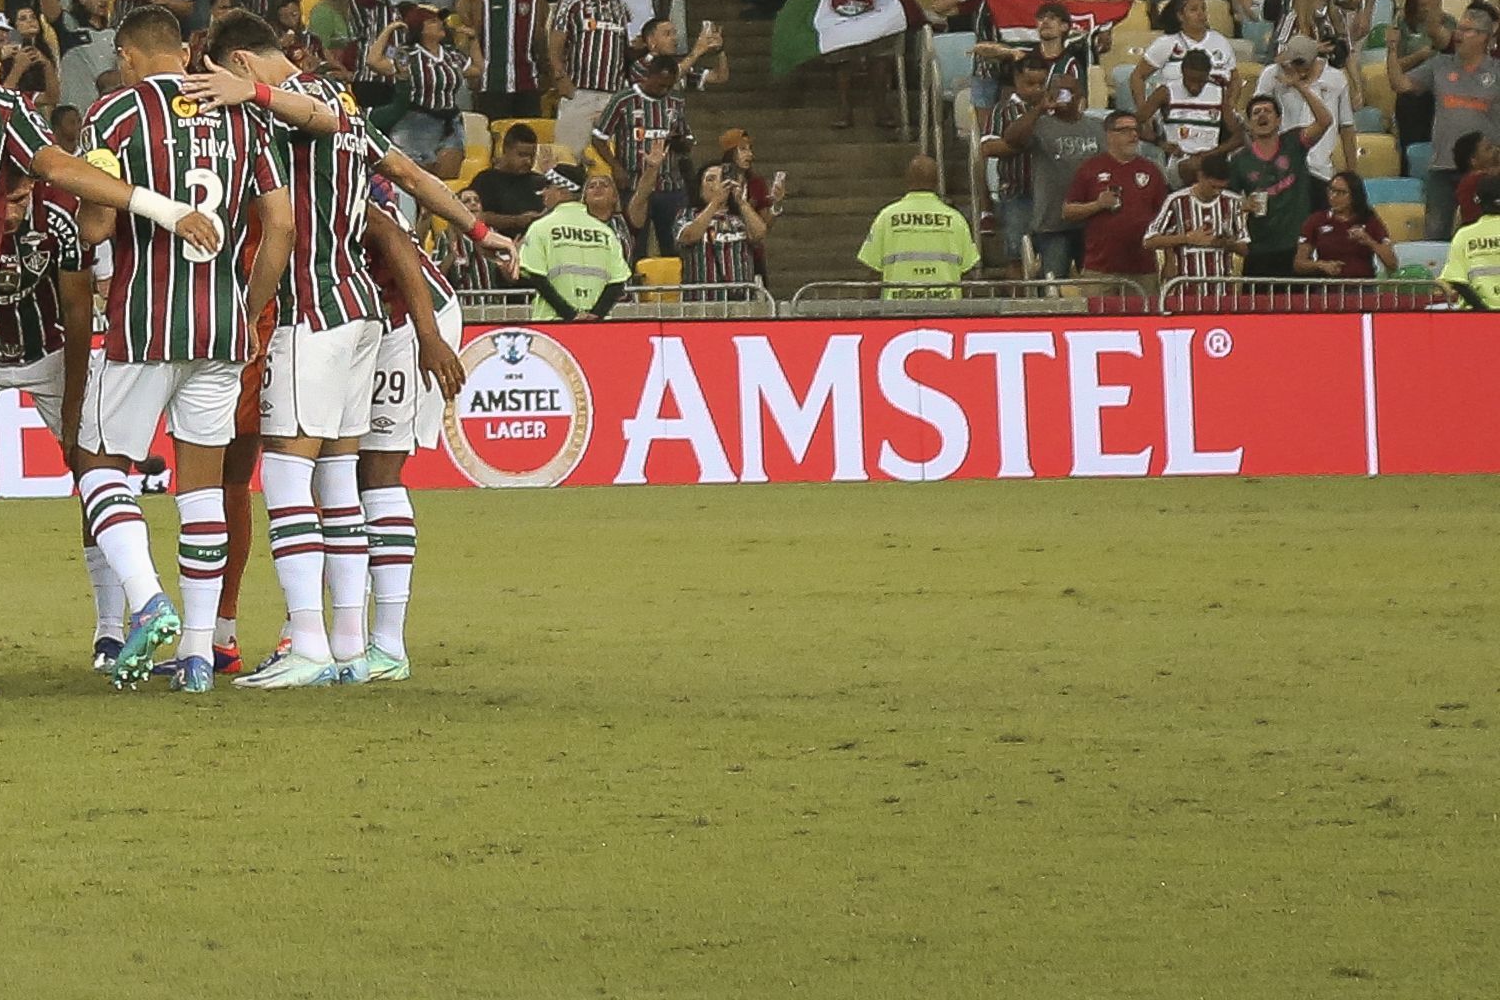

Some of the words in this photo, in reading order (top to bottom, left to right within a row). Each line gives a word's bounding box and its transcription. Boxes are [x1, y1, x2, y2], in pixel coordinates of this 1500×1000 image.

[191, 138, 236, 161] SILVA
[183, 168, 225, 262] 3
[891, 213, 953, 227] SUNSET
[551, 226, 611, 246] SUNSET
[371, 370, 405, 405] 29
[470, 389, 562, 413] AMSTEL
[614, 327, 1244, 485] AMSTEL
[486, 421, 547, 440] LAGER
